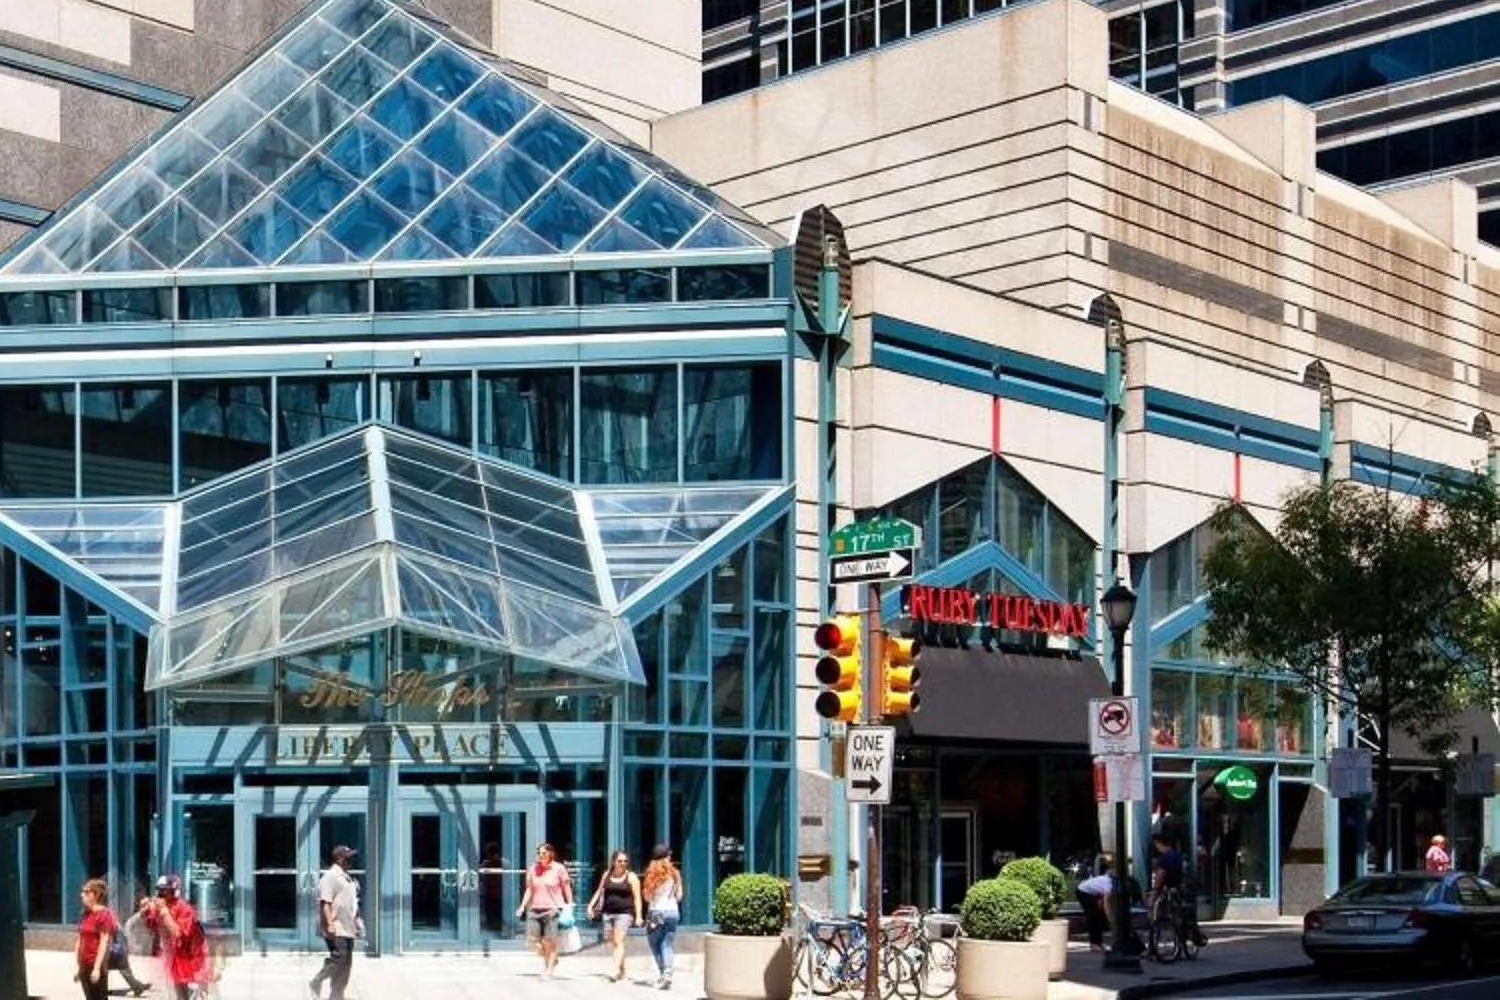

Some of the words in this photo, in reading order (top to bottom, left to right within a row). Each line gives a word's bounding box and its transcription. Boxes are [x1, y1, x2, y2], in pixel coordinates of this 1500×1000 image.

[851, 532, 885, 553] 17TH
[893, 533, 911, 547] ST
[865, 560, 889, 573] WAY
[910, 584, 978, 626] RUBY
[987, 592, 1091, 638] TUESDAY
[411, 733, 509, 758] PLACE
[853, 734, 885, 751] ONE
[851, 755, 885, 771] WAY
